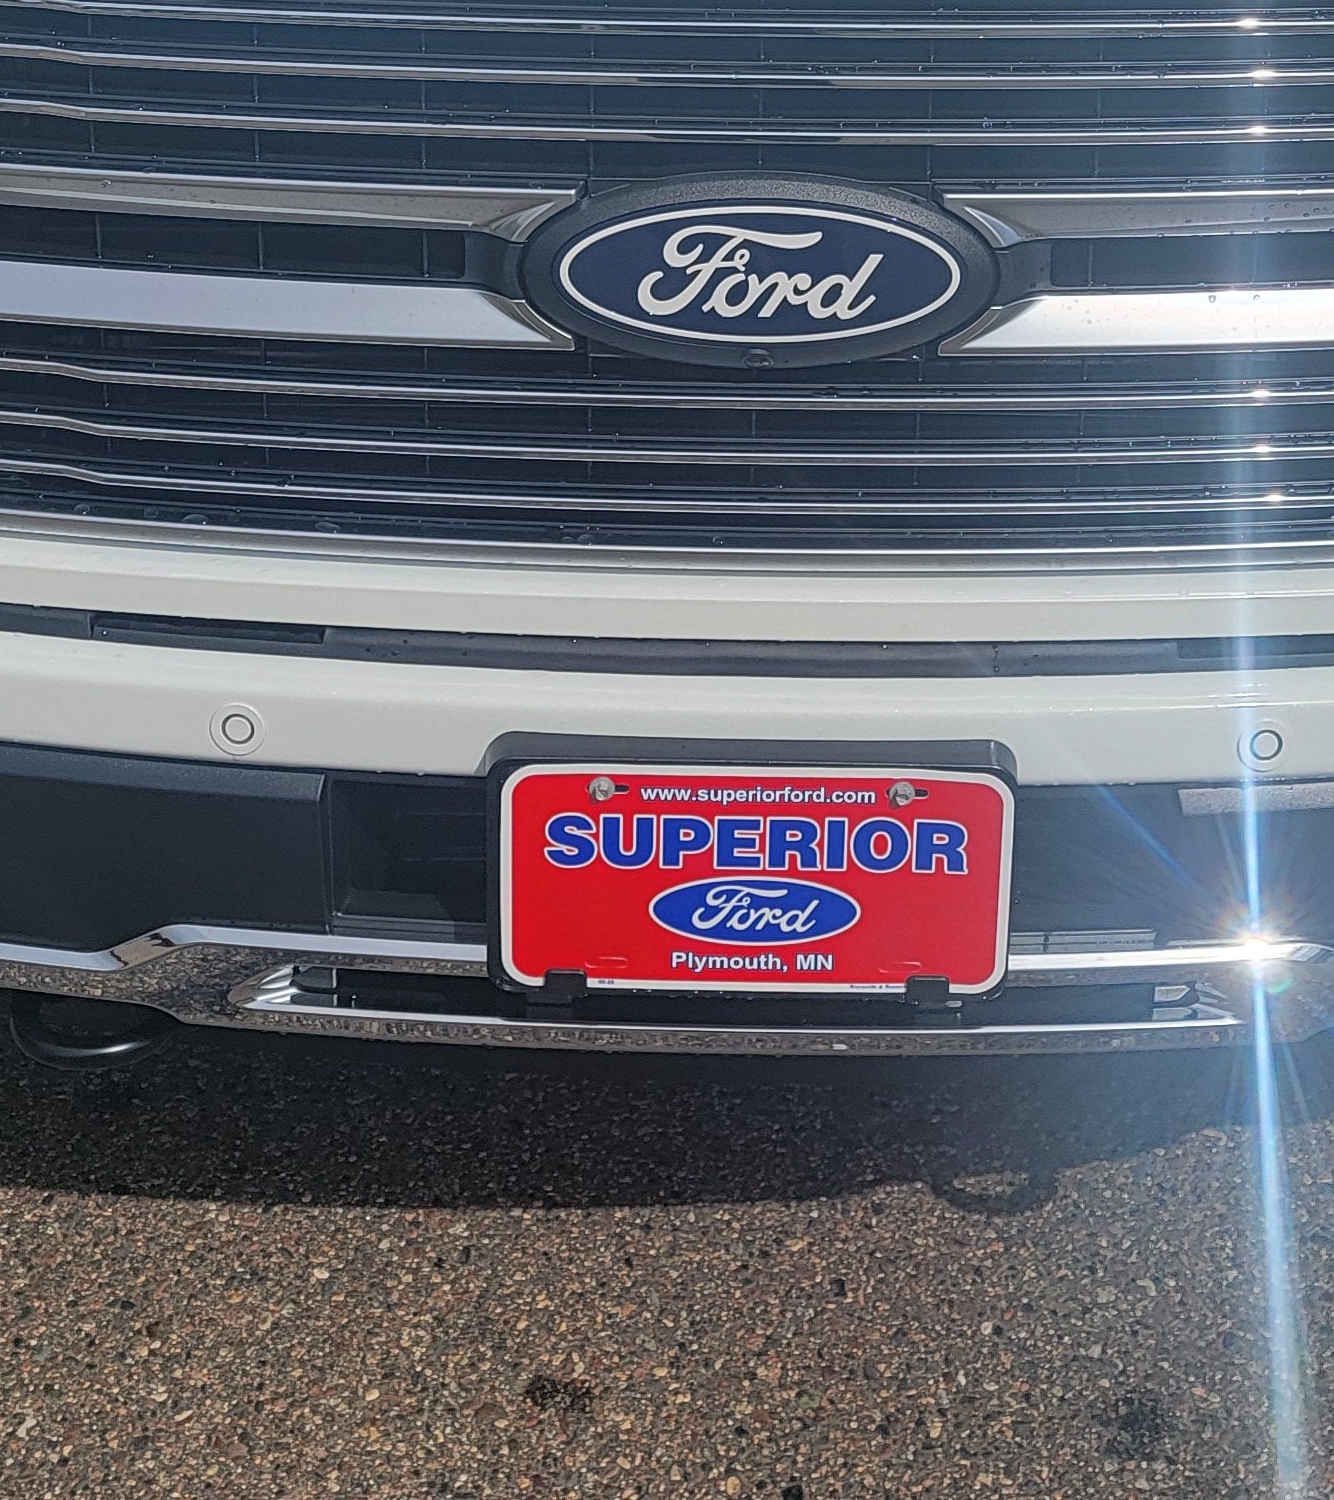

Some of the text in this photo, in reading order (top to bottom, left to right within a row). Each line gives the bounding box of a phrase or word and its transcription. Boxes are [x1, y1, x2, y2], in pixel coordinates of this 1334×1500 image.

[637, 225, 884, 321] Ford
[640, 785, 877, 805] www.superiorford.com
[545, 813, 968, 874] SUPERIOR
[691, 885, 820, 933] Ford
[670, 950, 833, 973] Plymouth, MN
